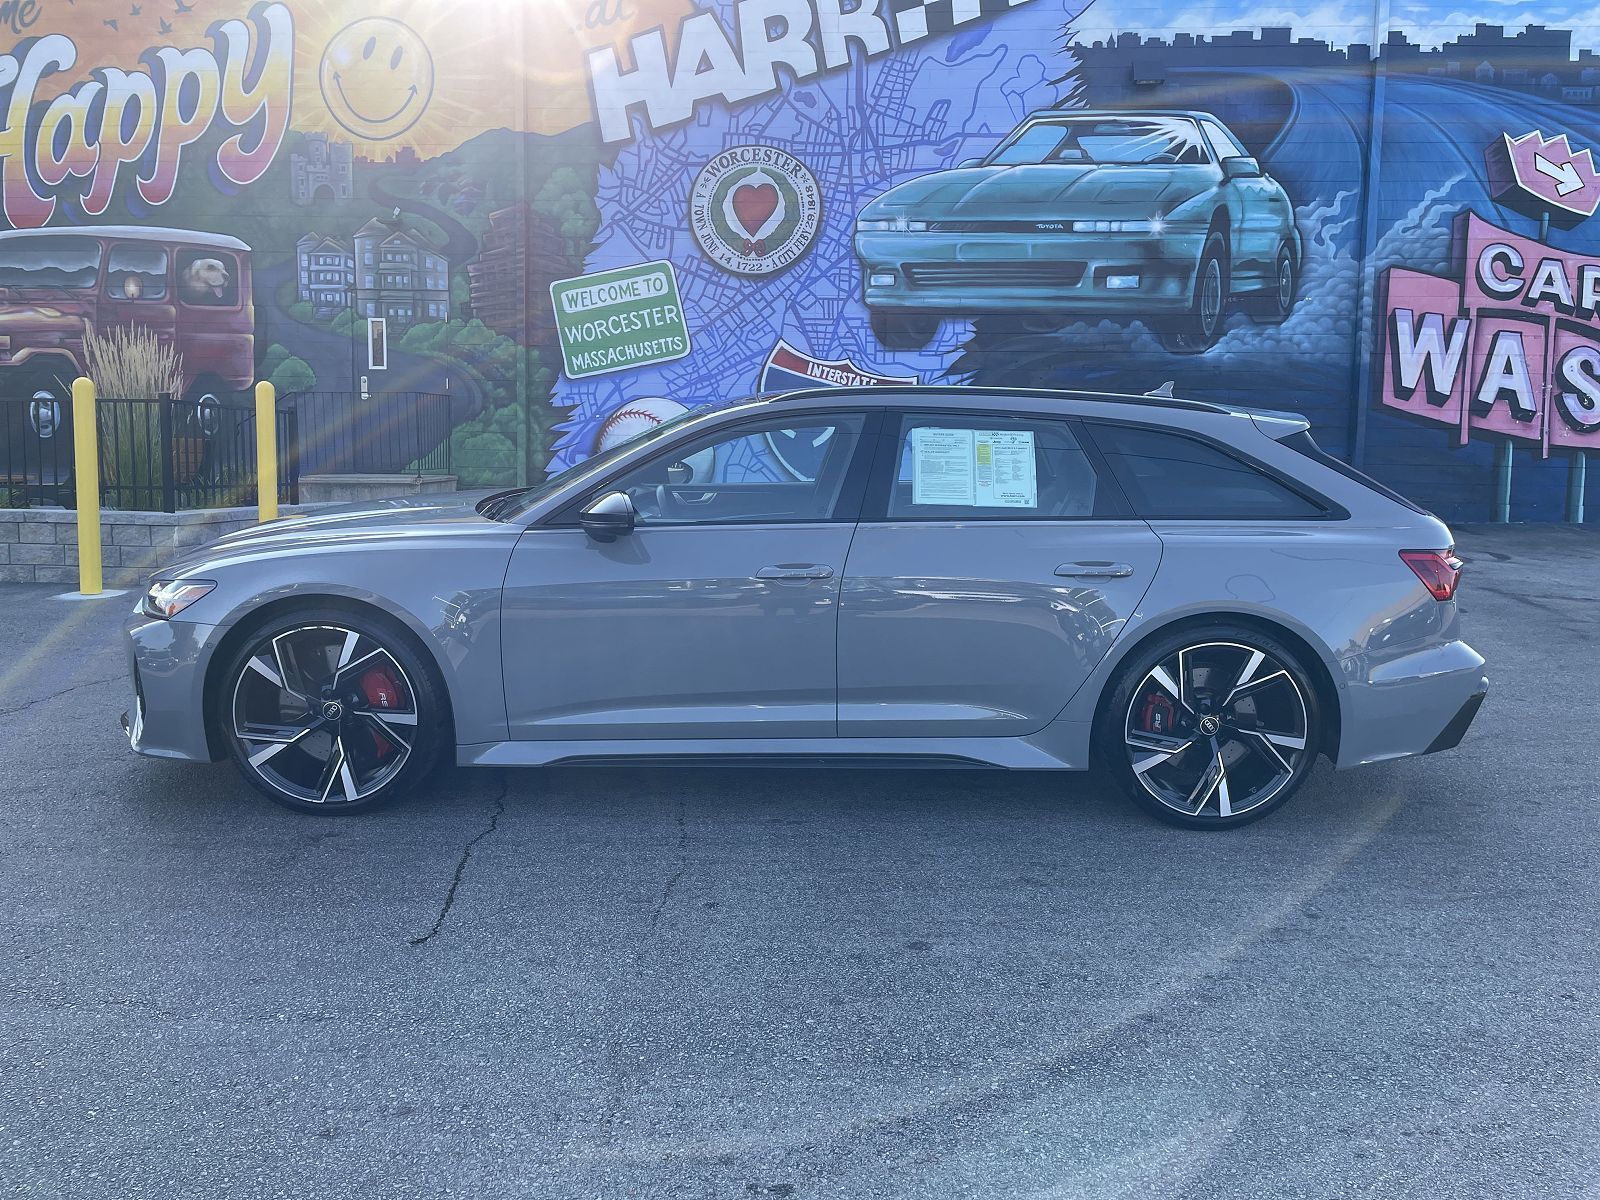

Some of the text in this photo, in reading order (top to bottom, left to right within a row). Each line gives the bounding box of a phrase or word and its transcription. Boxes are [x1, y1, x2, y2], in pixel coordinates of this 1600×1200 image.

[705, 148, 802, 178] WORCESTER
[694, 204, 708, 231] TOWN
[701, 233, 720, 255] JUNE
[737, 262, 763, 272] 1722
[778, 246, 797, 265] CITY
[565, 277, 664, 310] WELCOME TO
[564, 305, 679, 344] WORCESTER
[571, 336, 683, 371] MASSACHUSETTS
